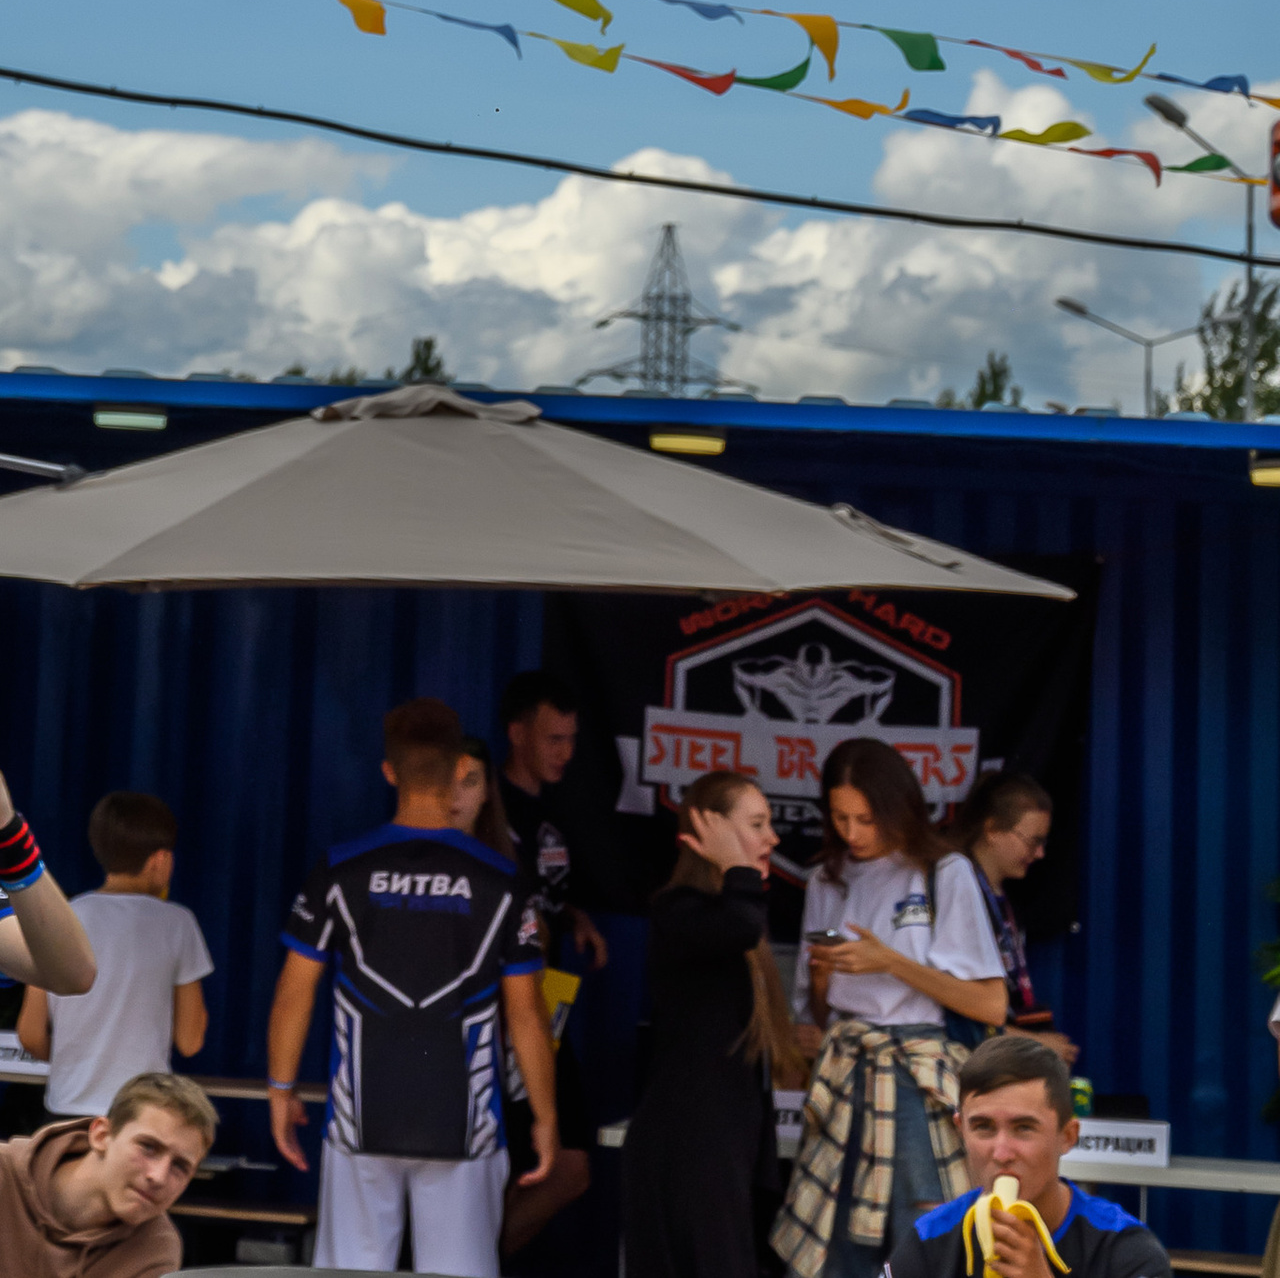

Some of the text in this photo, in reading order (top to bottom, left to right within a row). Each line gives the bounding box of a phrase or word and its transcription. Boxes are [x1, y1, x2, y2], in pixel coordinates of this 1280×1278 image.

[679, 592, 788, 635] WOR
[648, 724, 758, 775] STEEL
[369, 871, 472, 899] БИТВА
